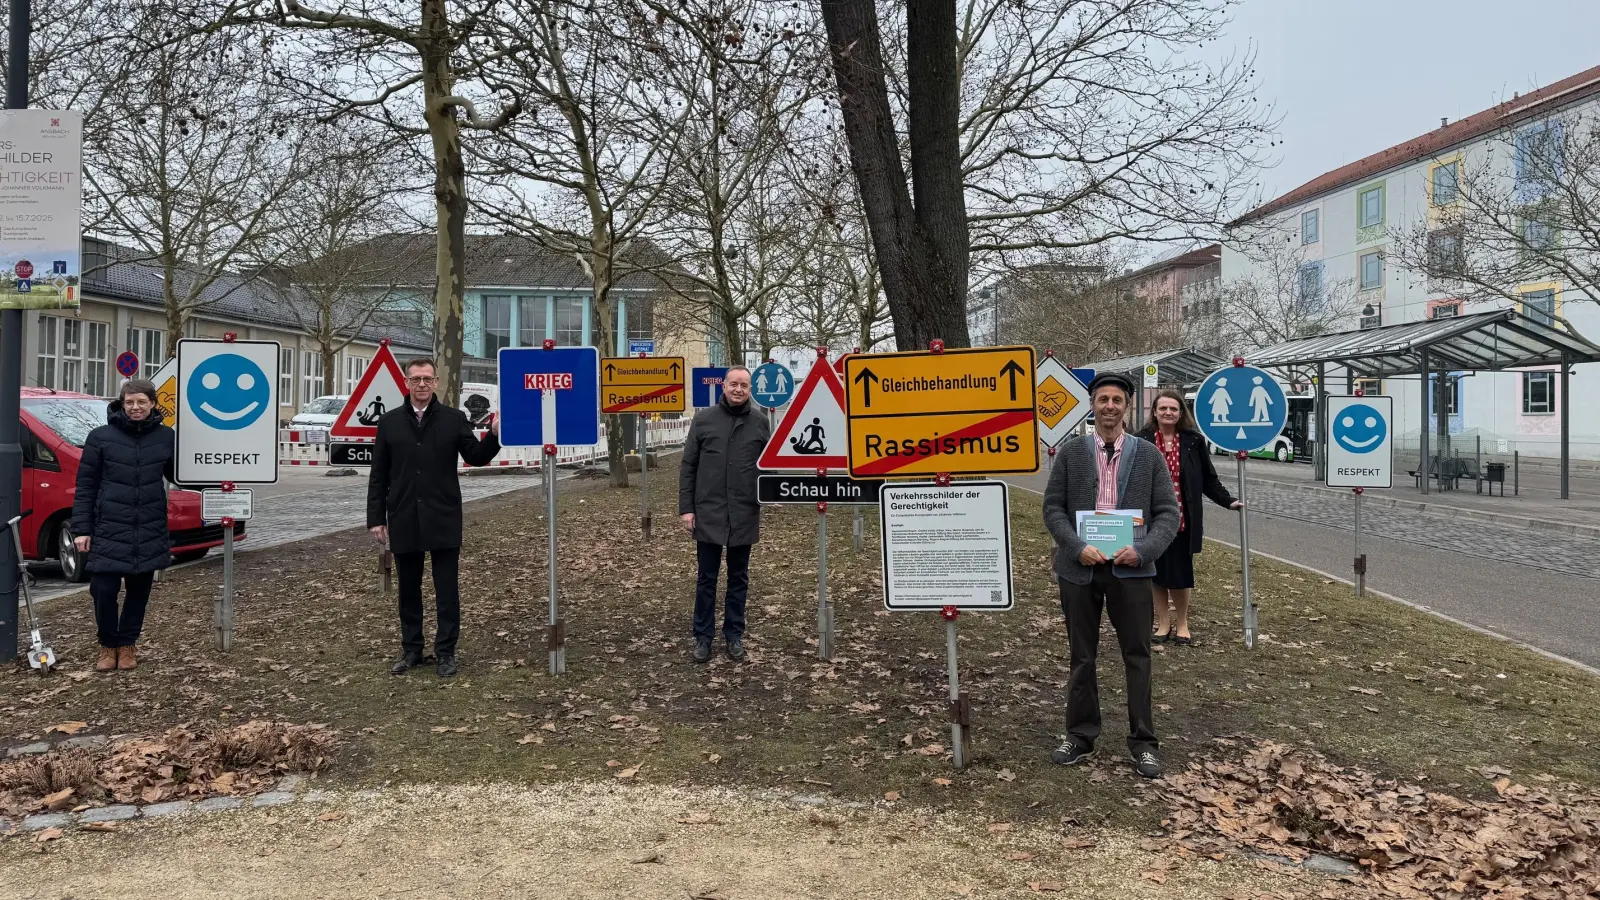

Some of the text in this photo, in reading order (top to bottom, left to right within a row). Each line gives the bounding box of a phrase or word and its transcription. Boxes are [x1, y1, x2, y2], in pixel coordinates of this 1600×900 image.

[0, 171, 74, 184] HTIGKEIT
[15, 214, 54, 222] 15.7.2025
[617, 368, 669, 376] Gleichbehandlung
[524, 373, 573, 389] KRIEG
[881, 375, 997, 393] Gleichbehandlung
[609, 393, 678, 404] Rassismus
[865, 432, 1020, 458] Rassismus
[194, 453, 260, 465] RESPEKT
[347, 448, 372, 461] Sch
[1337, 467, 1380, 476] RESPEKT
[780, 482, 861, 497] Schau hin
[890, 492, 963, 500] Verkehrsschilder
[891, 502, 949, 511] Gerechtigkeit
